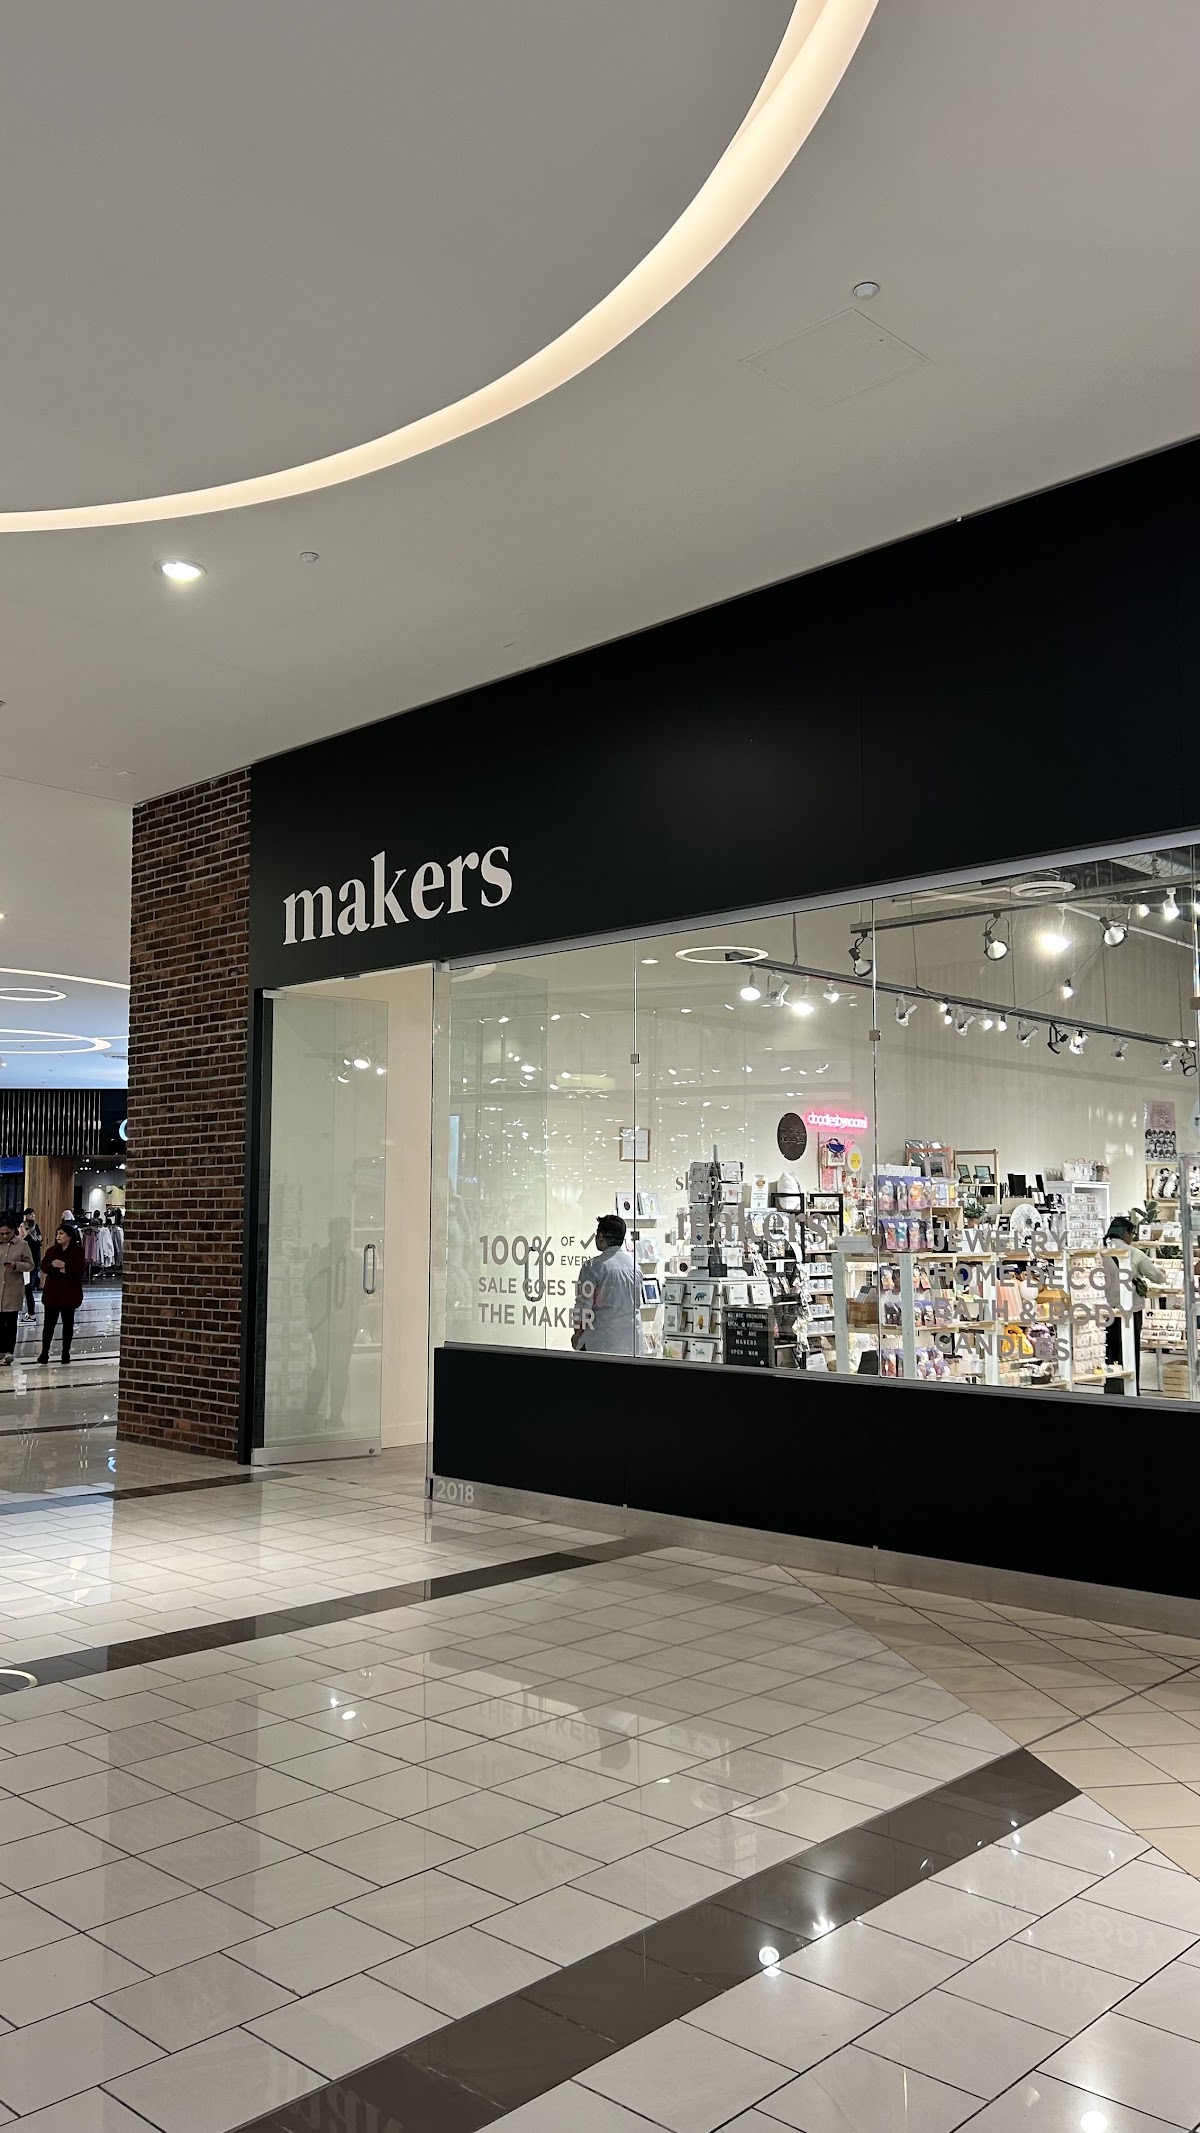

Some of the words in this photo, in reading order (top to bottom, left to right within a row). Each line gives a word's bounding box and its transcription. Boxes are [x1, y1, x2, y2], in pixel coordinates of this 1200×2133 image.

[282, 845, 513, 946] makers
[676, 1171, 716, 1196] shp
[677, 1202, 828, 1243] makers
[479, 1235, 555, 1266] 100%
[560, 1236, 575, 1247] OF
[933, 1228, 1068, 1253] JEWELRY
[560, 1255, 594, 1267] EVERY
[478, 1276, 517, 1294] SALE
[522, 1278, 566, 1296] GOES
[571, 1280, 595, 1298] TO
[932, 1263, 1014, 1288] HOME
[1026, 1266, 1134, 1292] DECOR
[478, 1303, 515, 1325] THE
[522, 1305, 595, 1331] MAKER
[934, 1296, 1008, 1322] BATH
[1020, 1299, 1037, 1323] &
[1049, 1302, 1135, 1328] BODY
[934, 1331, 1070, 1362] CANDLES
[436, 1479, 475, 1504] 2018
